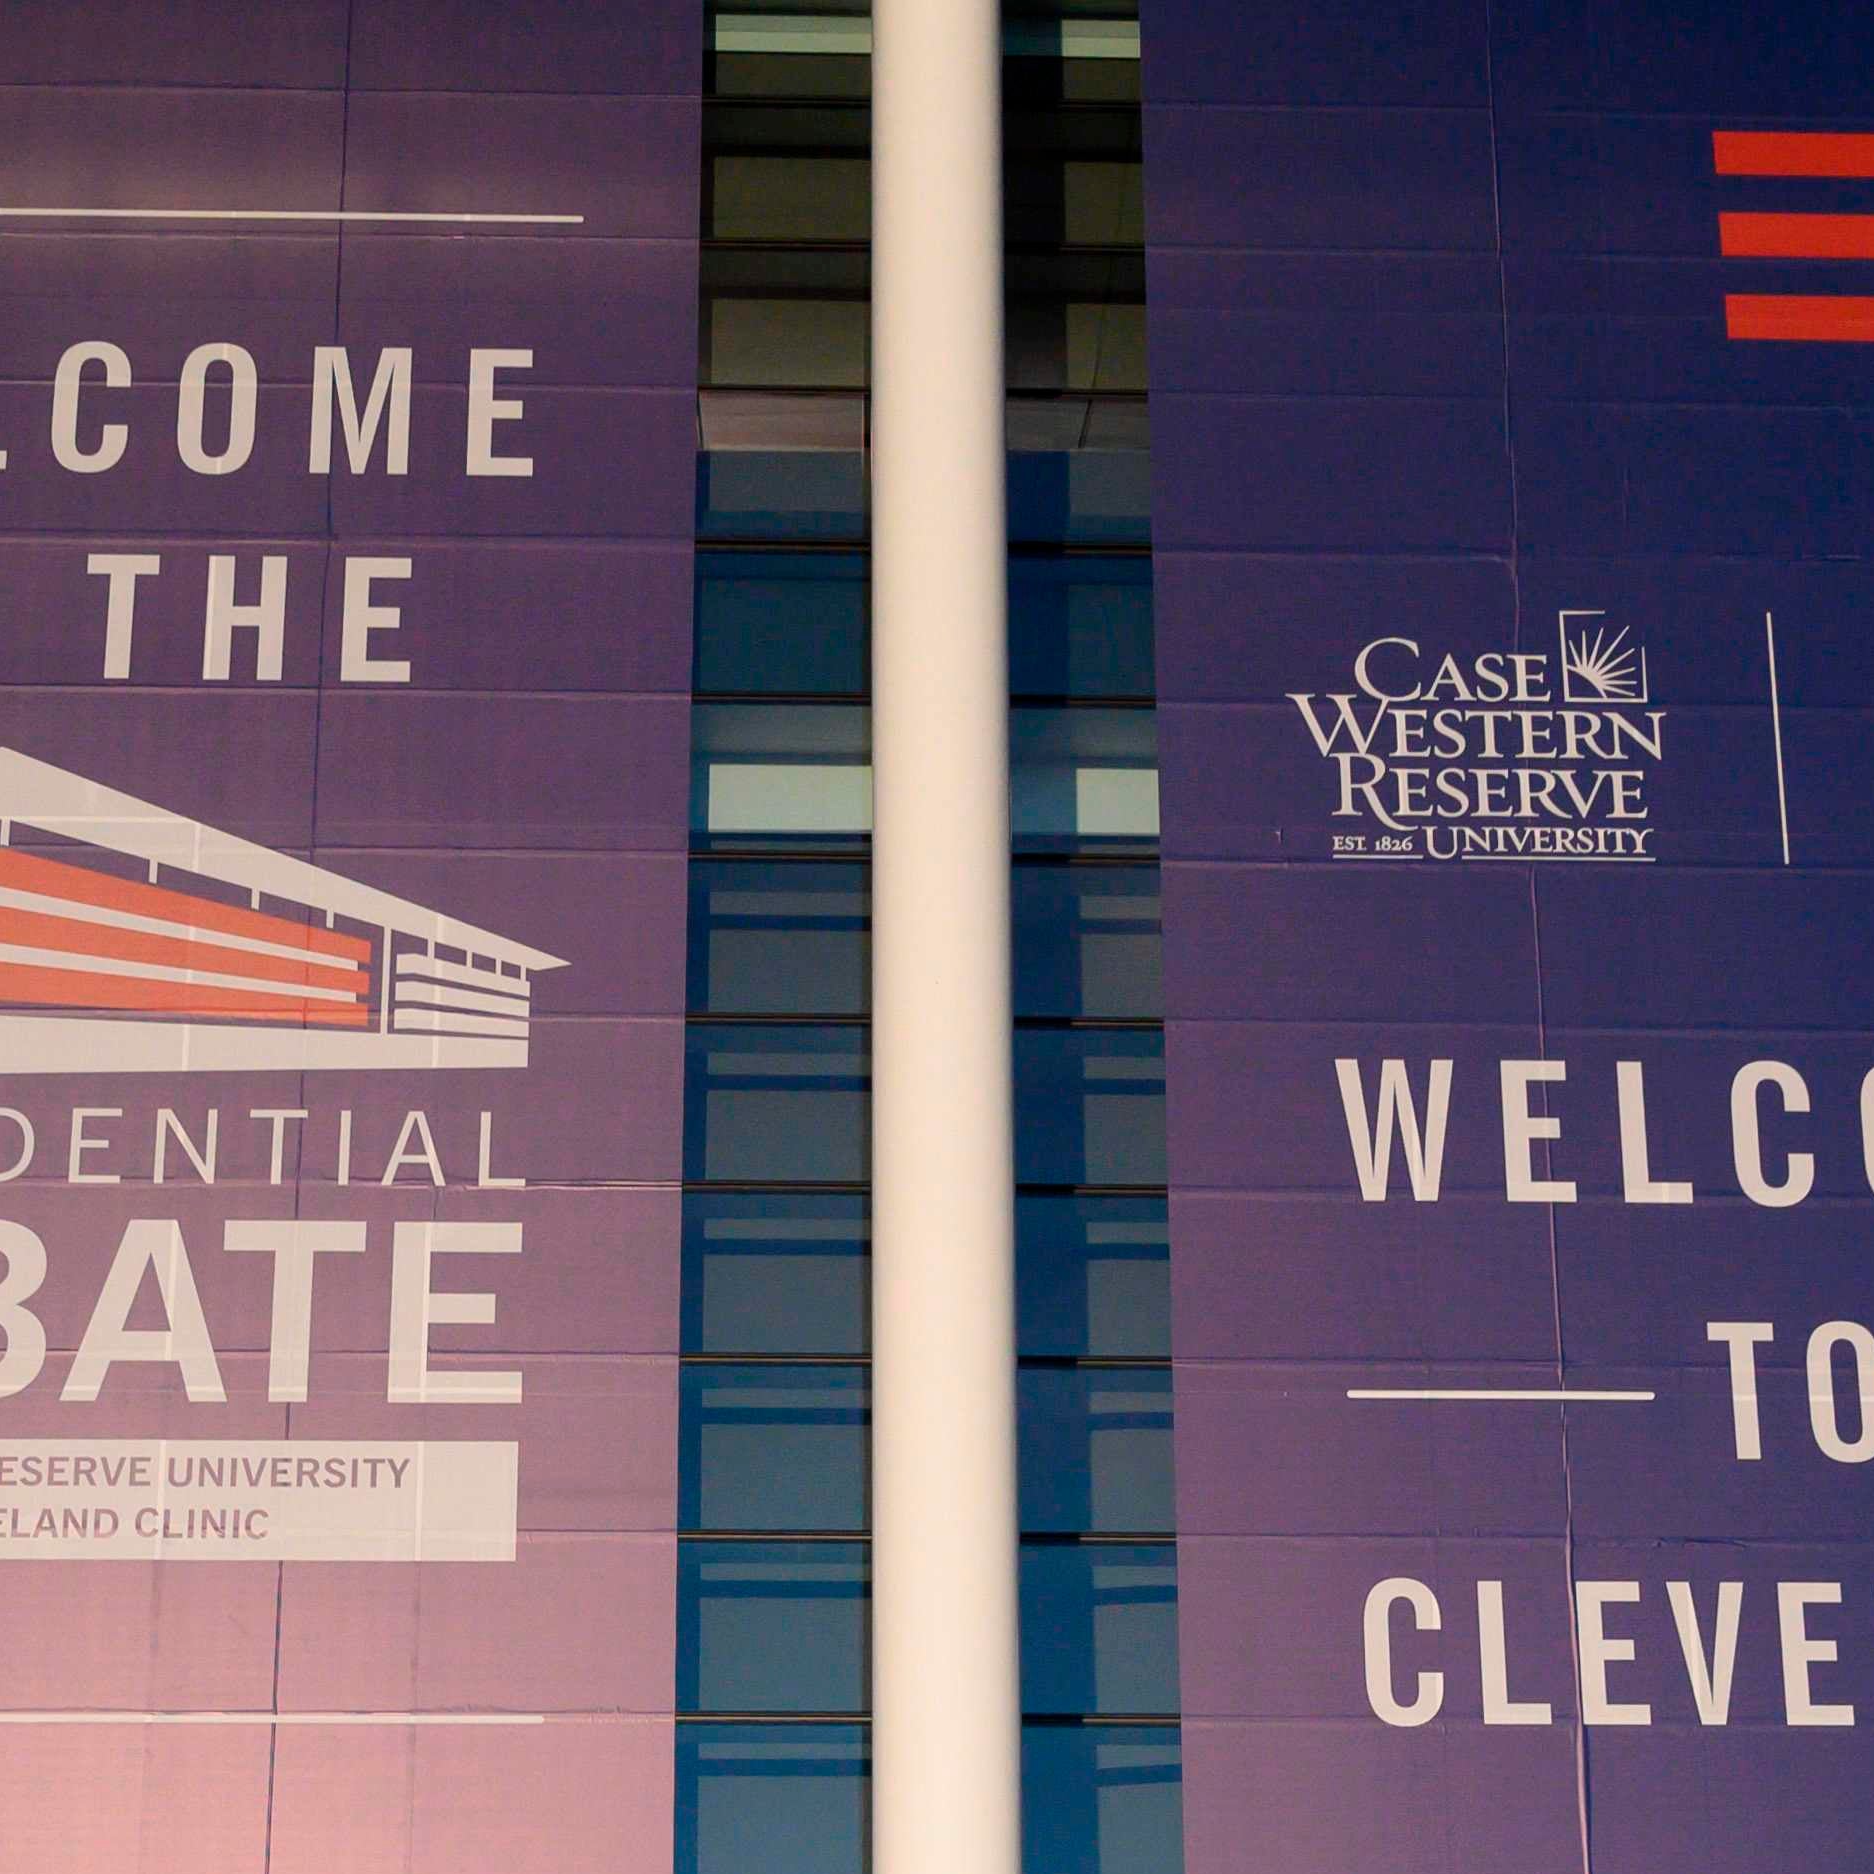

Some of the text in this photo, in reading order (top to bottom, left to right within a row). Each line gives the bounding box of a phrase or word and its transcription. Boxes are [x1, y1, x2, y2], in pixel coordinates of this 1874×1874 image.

[88, 554, 412, 682] THE
[1354, 637, 1551, 702] CASE
[1285, 693, 1667, 760] WESTERN
[1326, 753, 1649, 830] RESERVE
[1375, 835, 1413, 852] 1826
[1421, 825, 1654, 860] UNIVERSITY
[167, 1456, 412, 1489] UNIVERSITY
[134, 1508, 270, 1540] CLINIC
